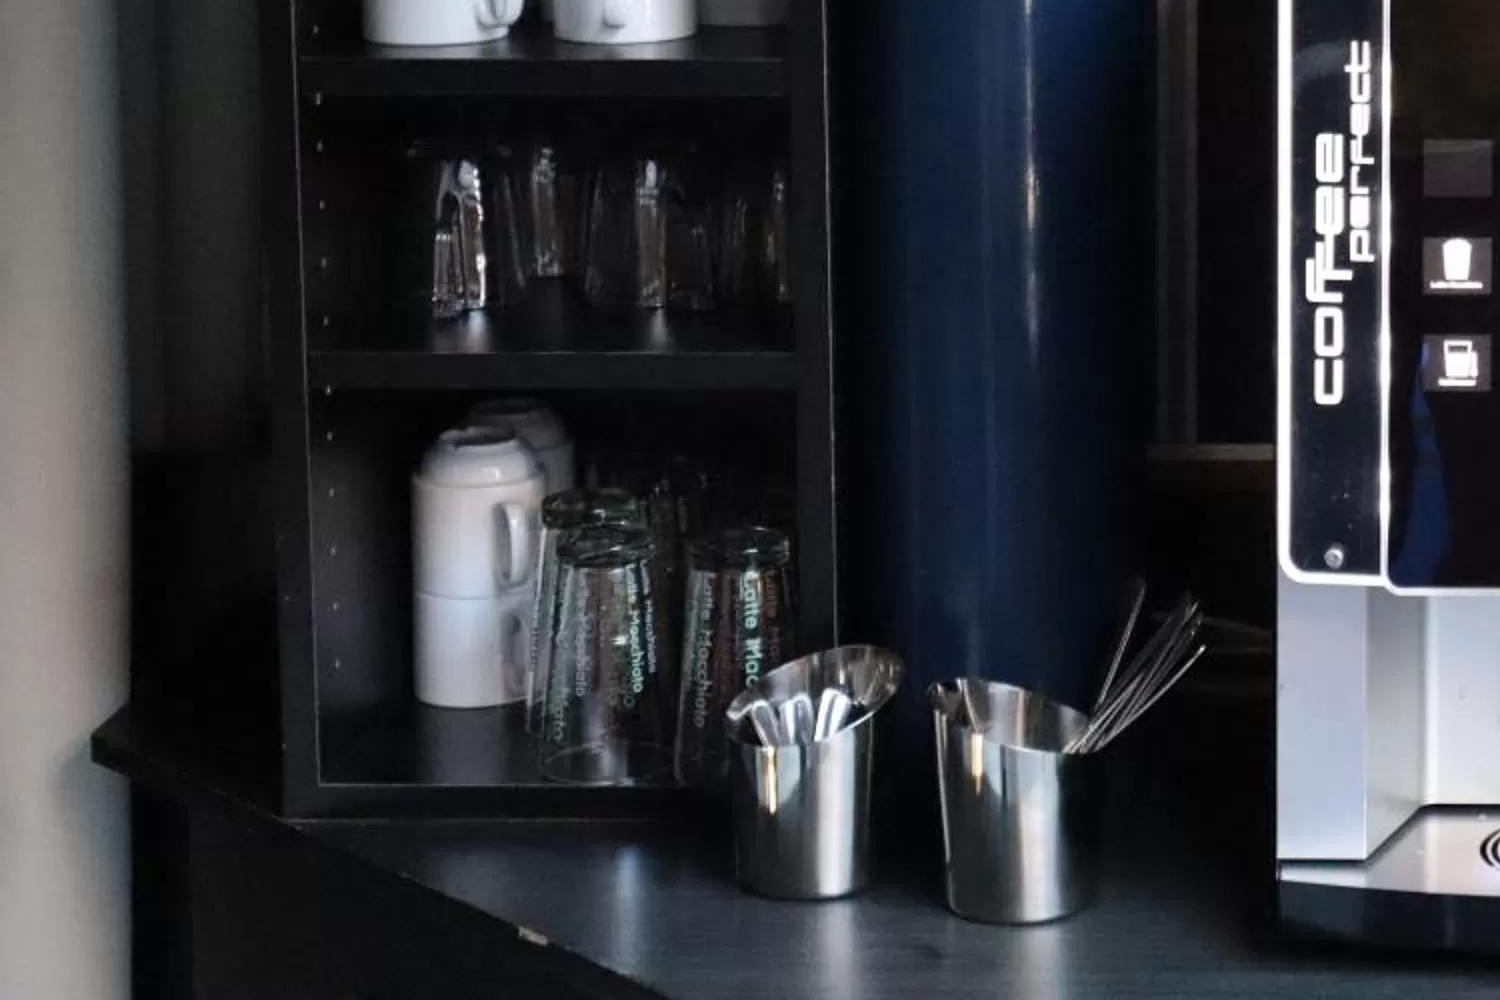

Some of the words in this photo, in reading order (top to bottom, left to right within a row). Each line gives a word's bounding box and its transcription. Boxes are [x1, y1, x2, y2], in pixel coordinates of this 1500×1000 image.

[1343, 40, 1376, 263] perfect
[1305, 132, 1354, 405] coffee
[743, 567, 762, 630] Latte
[693, 629, 713, 729] Macchiato
[744, 637, 764, 690] Mac
